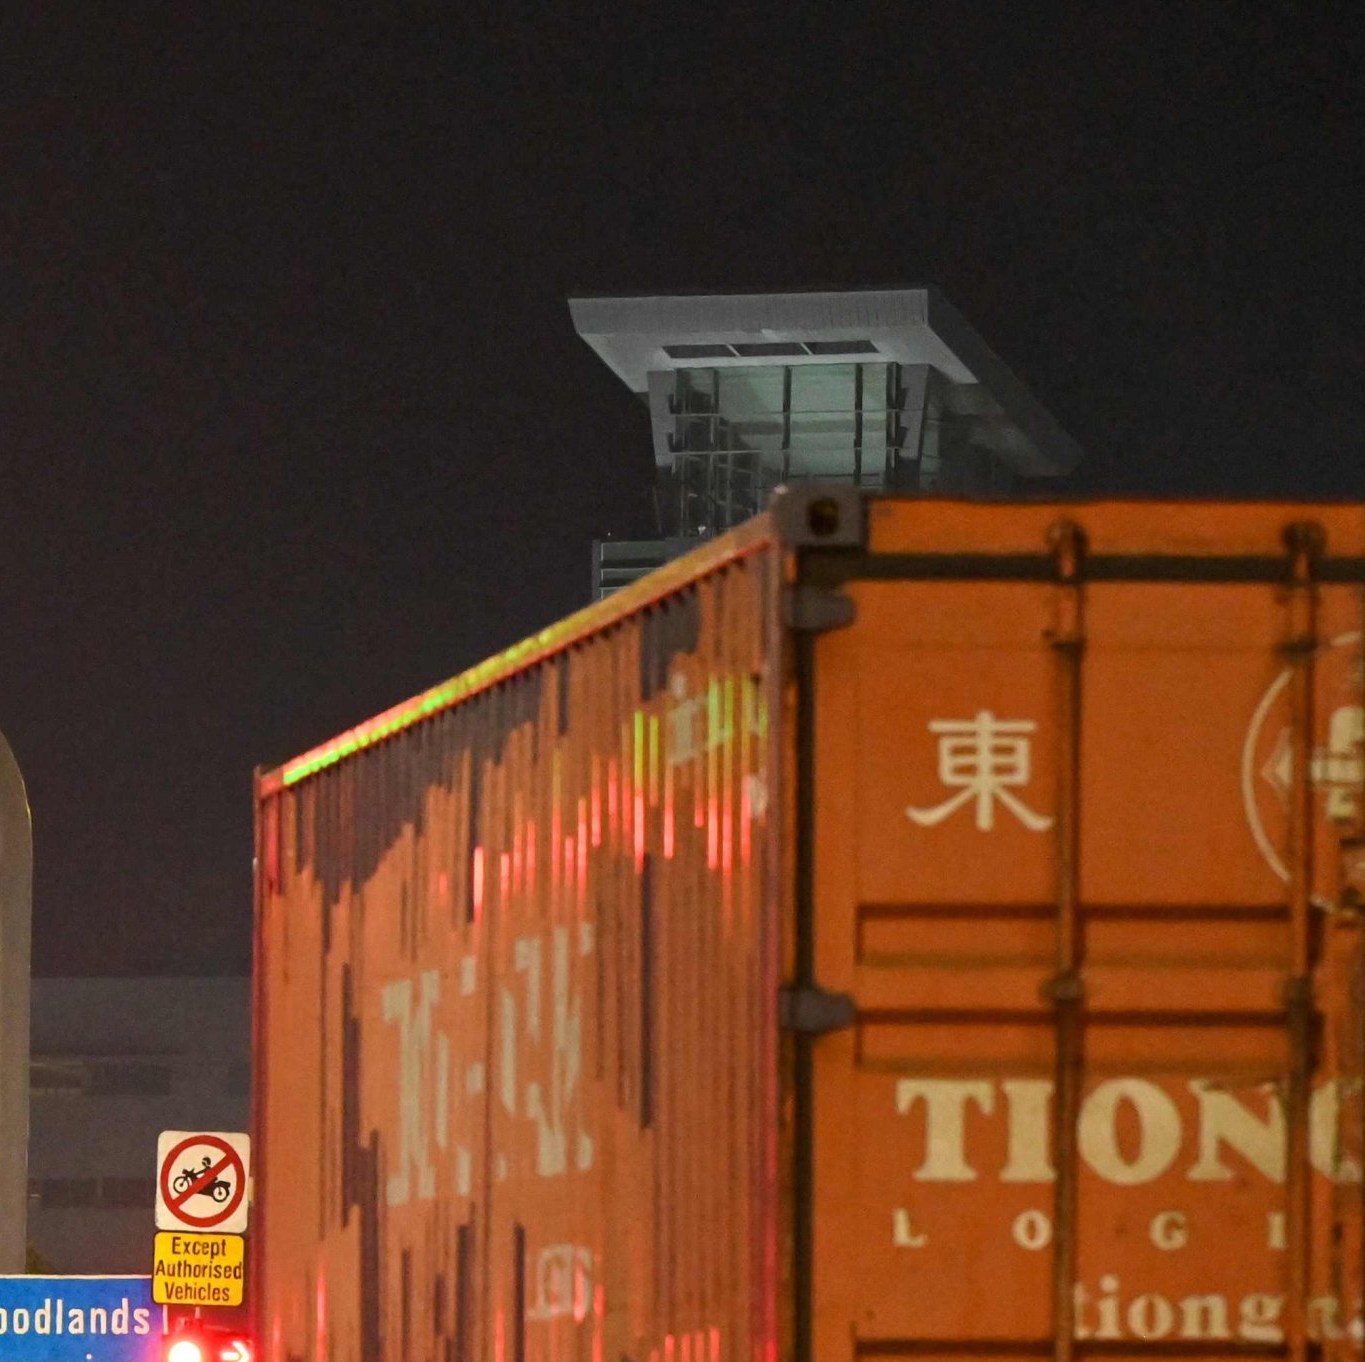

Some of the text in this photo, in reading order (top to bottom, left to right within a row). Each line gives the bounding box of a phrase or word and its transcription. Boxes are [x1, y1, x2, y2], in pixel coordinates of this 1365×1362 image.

[906, 710, 1053, 832] 東
[171, 1236, 226, 1258] Except
[154, 1260, 244, 1281] Authorised
[164, 1282, 231, 1303] Vehicles
